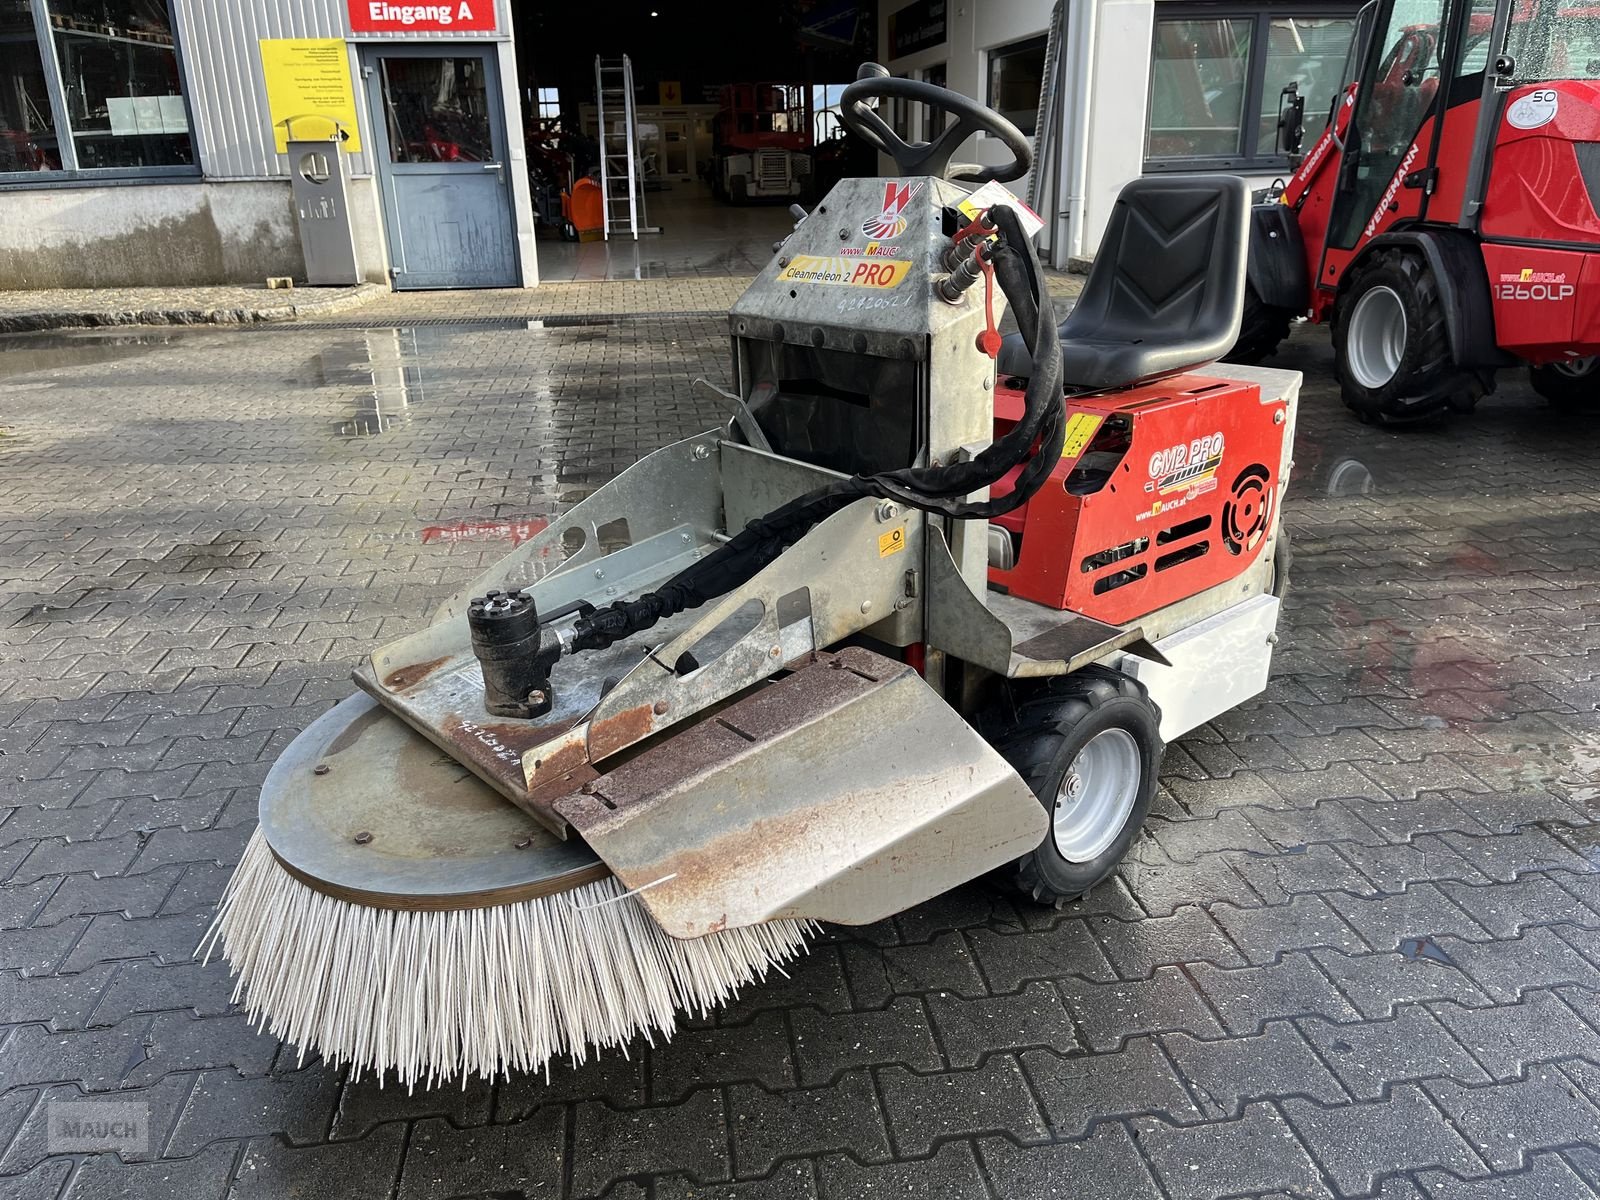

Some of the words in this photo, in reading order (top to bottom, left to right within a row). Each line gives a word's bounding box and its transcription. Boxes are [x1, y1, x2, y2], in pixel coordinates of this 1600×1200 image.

[369, 1, 452, 25] Eingang
[457, 1, 474, 21] A
[1533, 91, 1557, 103] 50
[1364, 142, 1420, 238] WEIDEMANN
[786, 267, 842, 282] Cleanmeleon
[843, 271, 851, 282] 2
[851, 262, 896, 286] PRO
[1494, 284, 1574, 301] 1260LP
[1149, 444, 1187, 478] CM2
[1189, 432, 1224, 465] PRO
[1135, 499, 1187, 521] www.MAUCH.at
